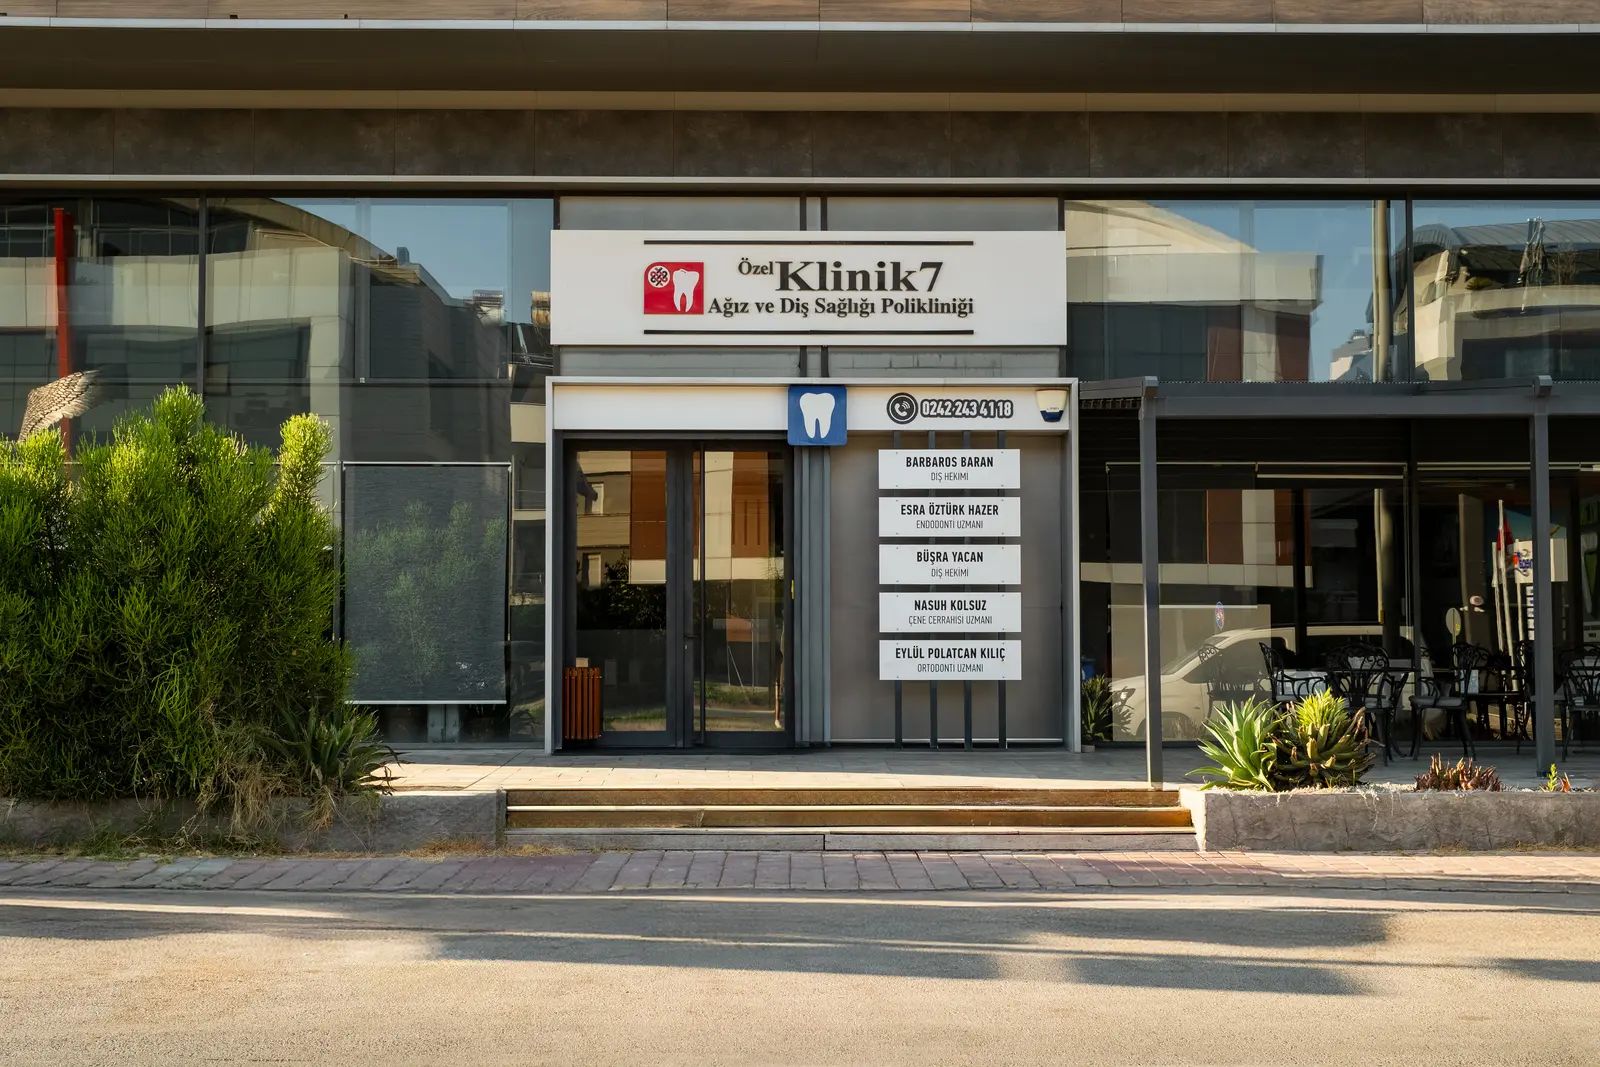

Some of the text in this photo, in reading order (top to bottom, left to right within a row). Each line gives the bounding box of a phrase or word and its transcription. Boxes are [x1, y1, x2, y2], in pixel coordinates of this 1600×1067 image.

[738, 257, 944, 292] Özel Klinik7
[708, 297, 975, 319] Ağız ve Diş Sağlığı Polikliniği
[921, 400, 952, 416] 0242
[954, 400, 977, 417] 243
[906, 456, 994, 468] BARBAROS BARAN
[901, 501, 999, 516] ESRA ÖZTÜRK HAZER
[916, 518, 984, 529] ENDODONTİ UZMANI
[917, 549, 984, 566] BÜŞRA YACAN
[914, 599, 987, 611] NASUH KOLSUZ
[908, 615, 927, 627] ÇENE
[966, 615, 993, 625] UZMANI
[895, 645, 1006, 662] EYLÜL POLATCAN KILIÇ
[917, 663, 984, 673] ORTODONTİ UZMANI
